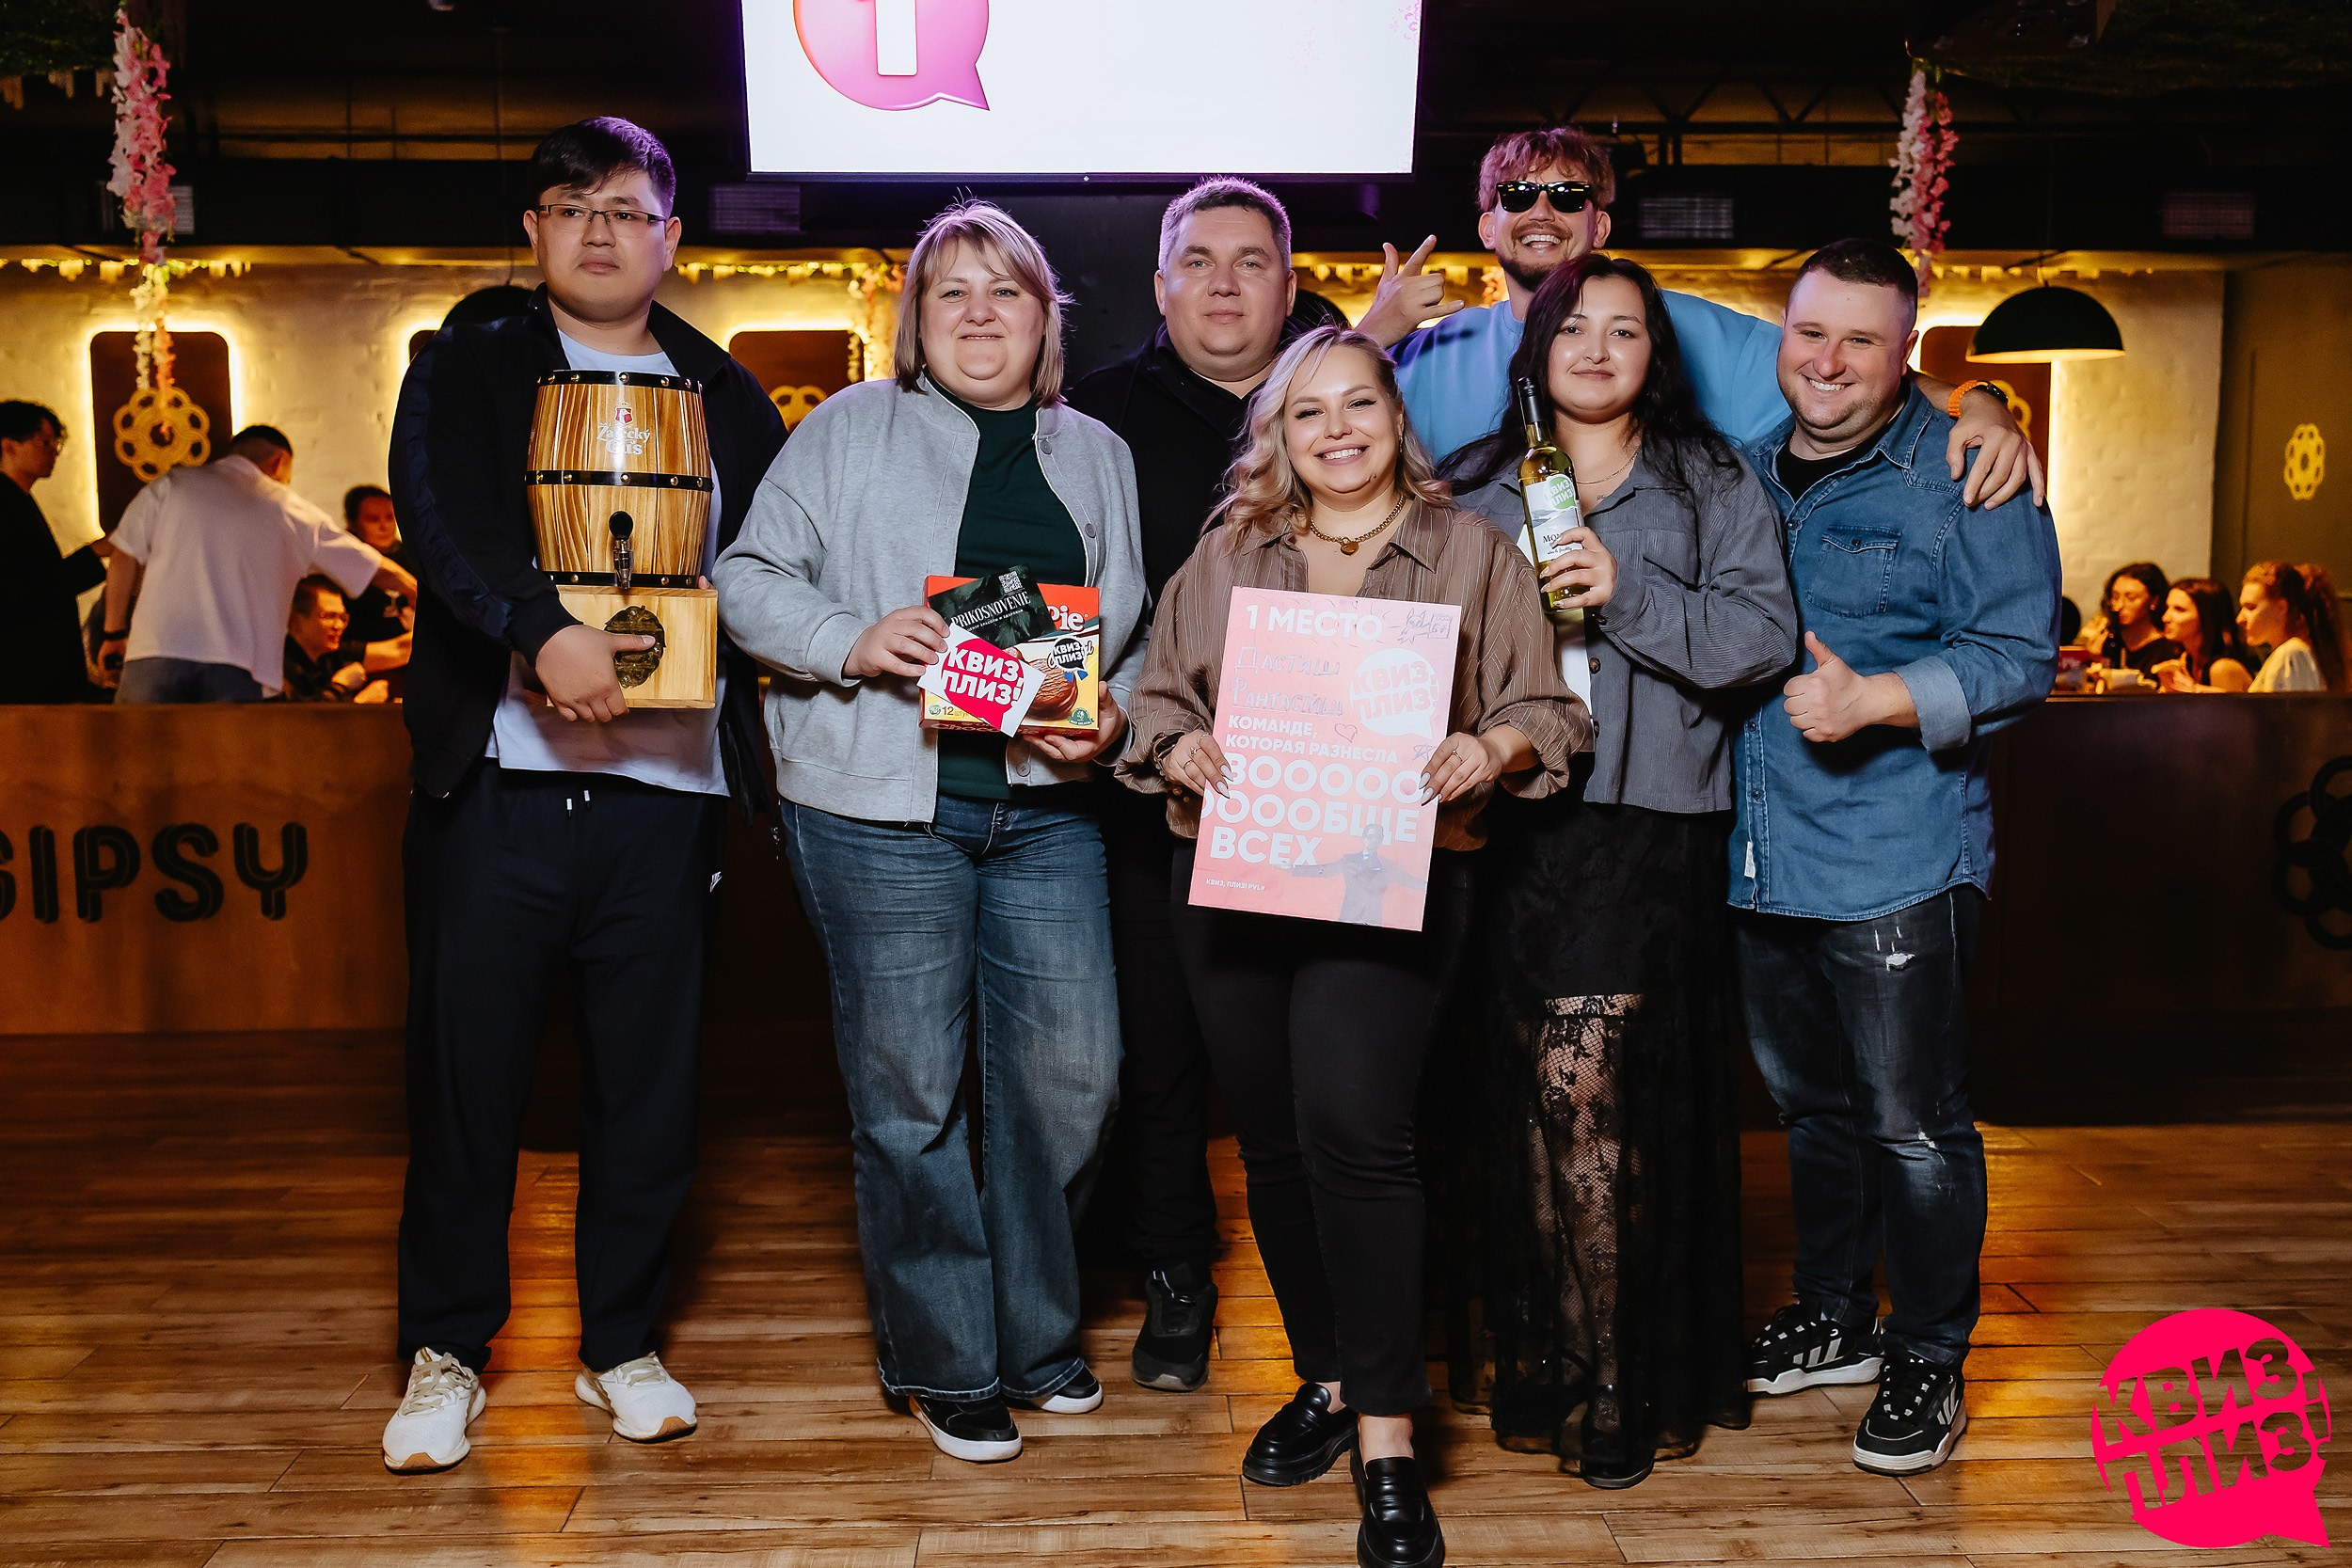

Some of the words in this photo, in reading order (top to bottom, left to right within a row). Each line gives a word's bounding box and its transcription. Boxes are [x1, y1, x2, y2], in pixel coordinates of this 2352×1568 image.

[596, 421, 650, 443] Žacký
[951, 591, 1031, 627] PRIKOSNOVENIE
[1247, 604, 1259, 630] 1
[1268, 606, 1383, 641] МЕСТО
[942, 669, 1021, 707] ПЛИЗ!
[943, 706, 954, 716] 12
[1228, 715, 1317, 738] КОМАНДЕ,
[1225, 734, 1306, 753] КОТОРАЯ
[1309, 741, 1399, 764] РАЗНЕСЛА
[1210, 825, 1323, 866] ВСЕХ
[0, 821, 309, 924] IPSY
